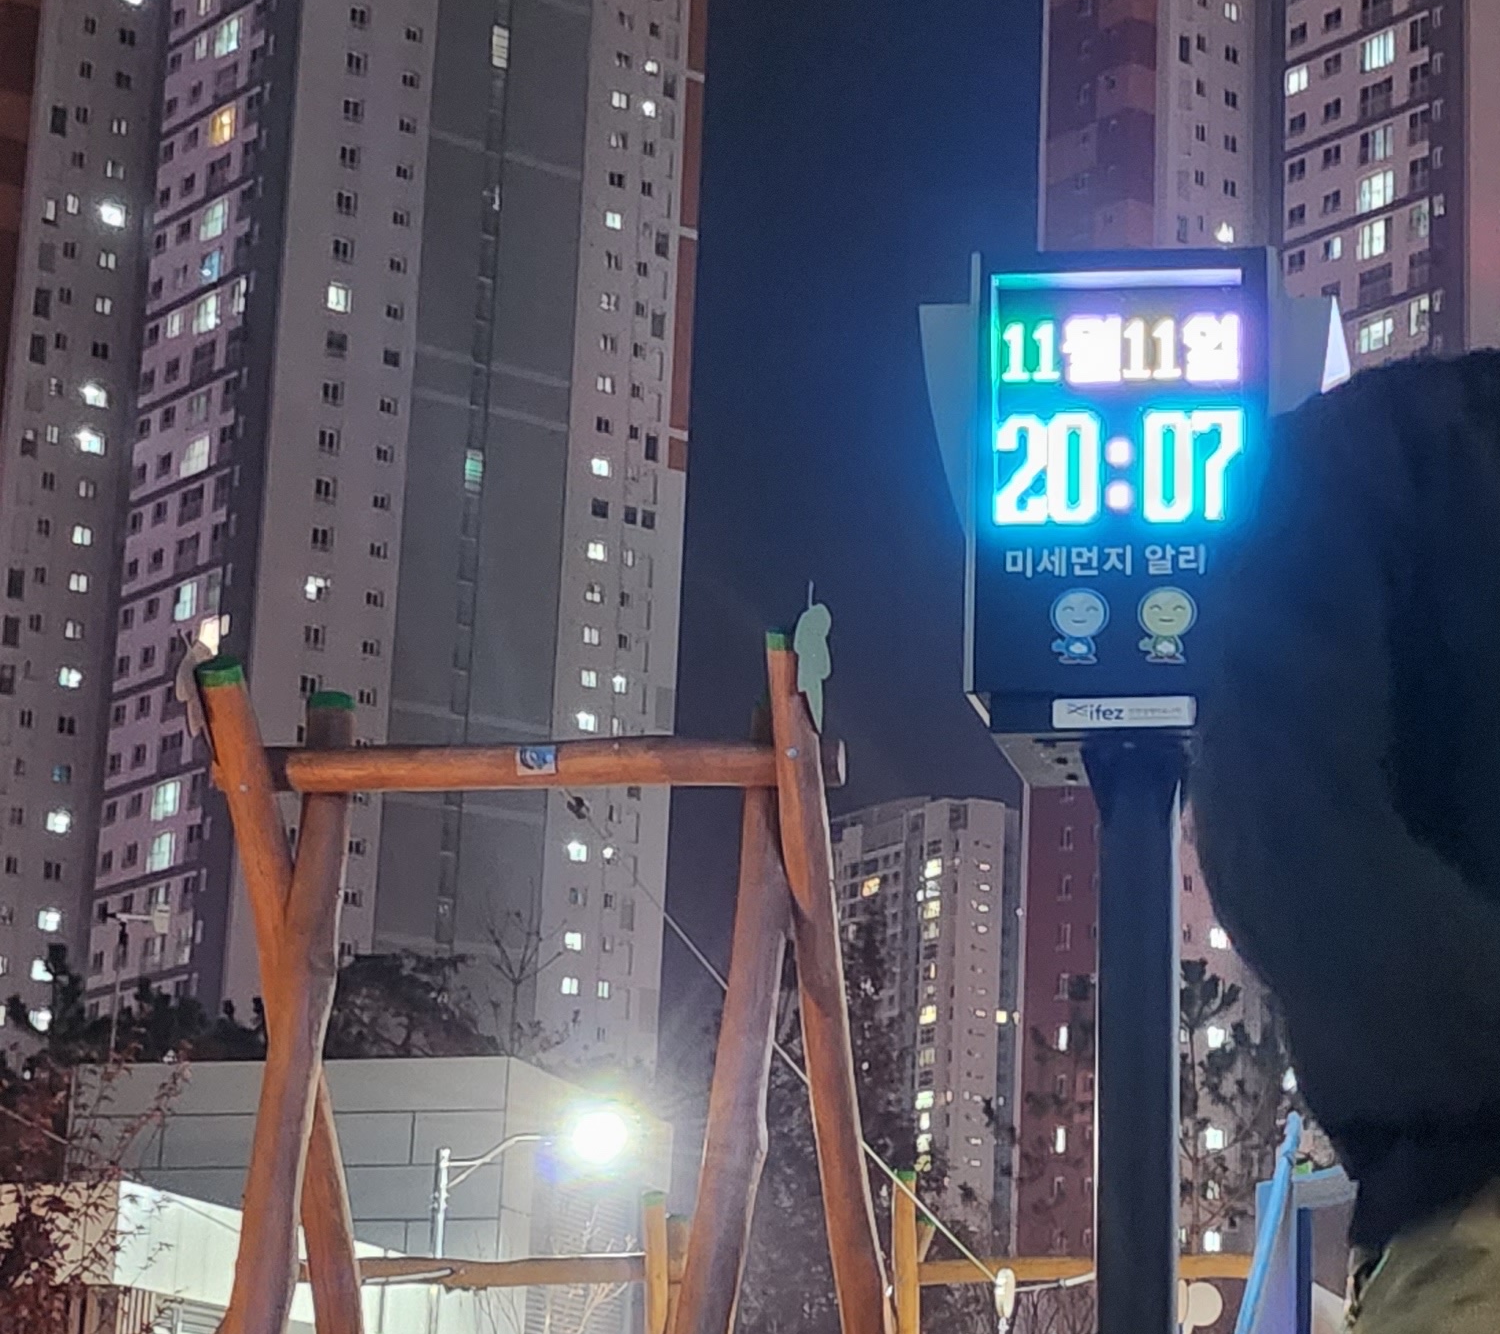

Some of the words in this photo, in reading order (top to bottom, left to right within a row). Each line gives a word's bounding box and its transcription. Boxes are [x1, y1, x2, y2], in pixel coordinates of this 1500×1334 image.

[993, 407, 1244, 525] 20:07
[1005, 544, 1132, 578] 미세먼지
[1145, 544, 1207, 575] 알리
